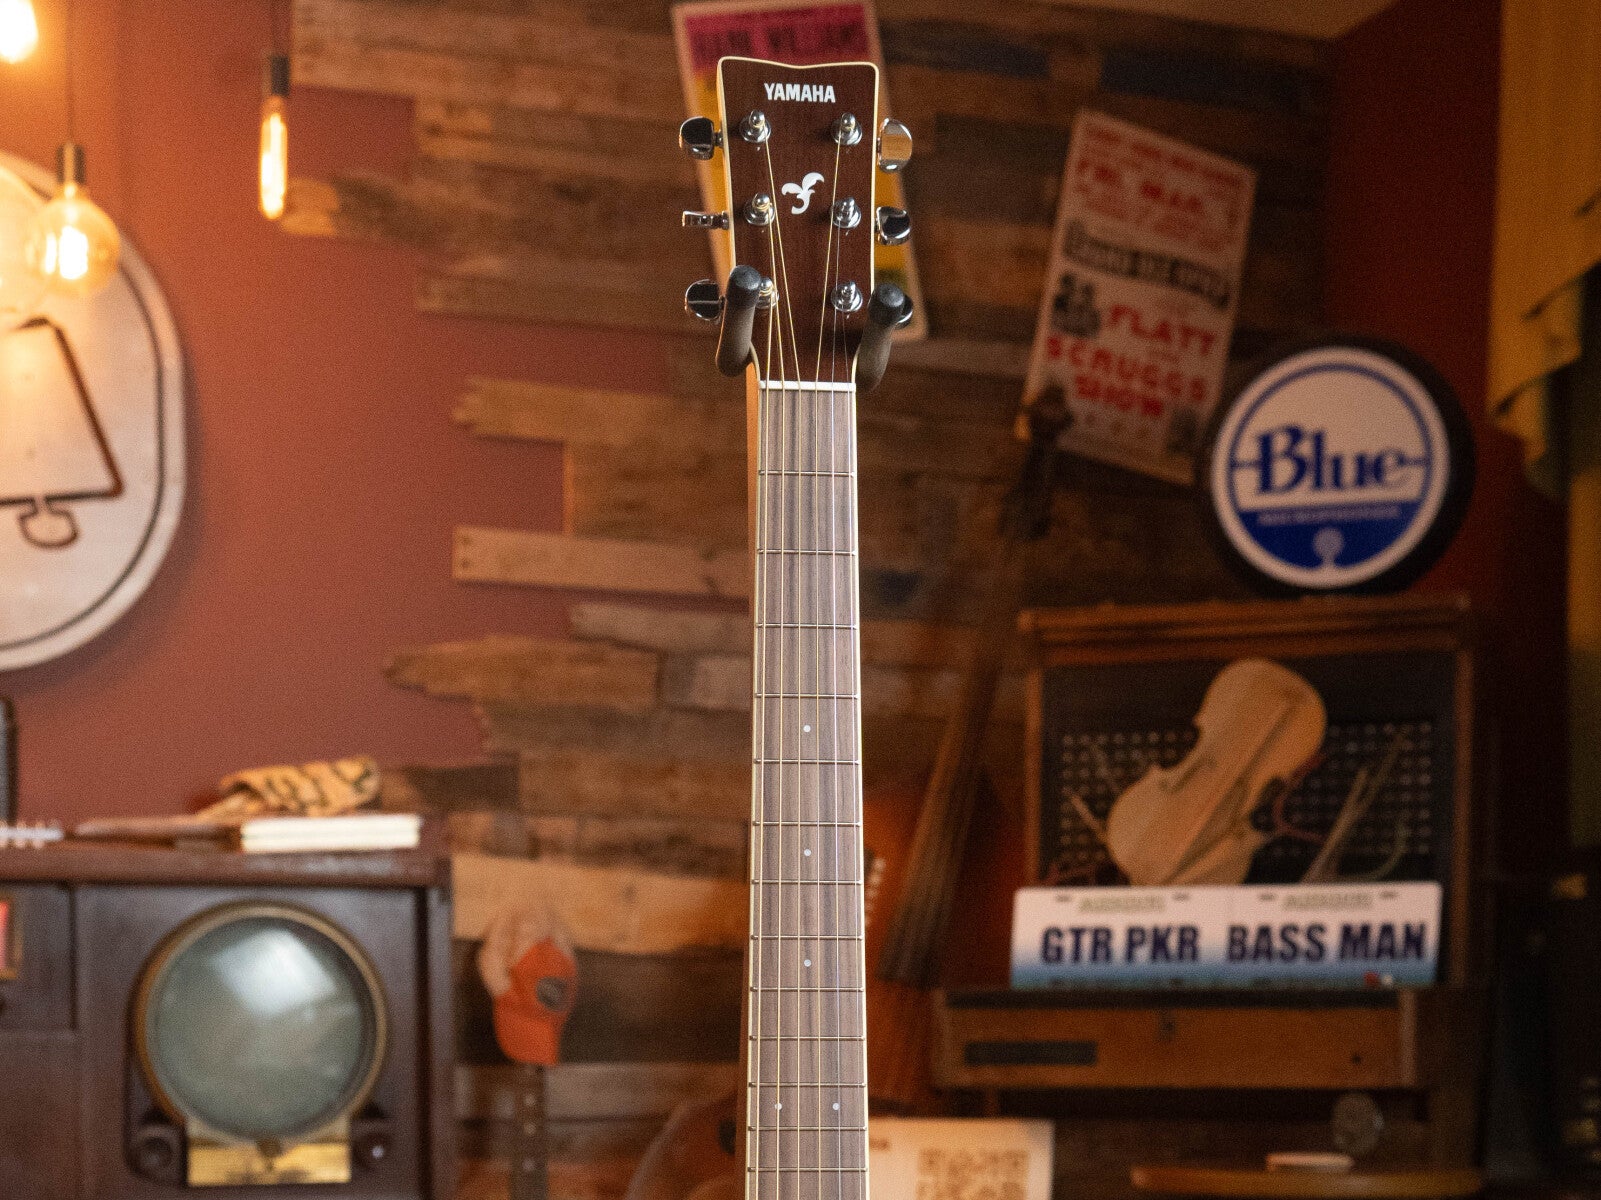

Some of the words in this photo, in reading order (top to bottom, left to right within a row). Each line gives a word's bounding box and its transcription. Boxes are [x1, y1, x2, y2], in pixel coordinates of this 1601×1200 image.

[764, 82, 836, 104] YAMAHA
[1108, 303, 1218, 357] FLATT
[1047, 333, 1207, 404] SCRUGGS
[1256, 423, 1410, 494] Blue
[1040, 924, 1113, 965] GTR
[1124, 924, 1200, 964] PKR
[1226, 922, 1326, 963] BASS
[1338, 921, 1427, 961] MAN
